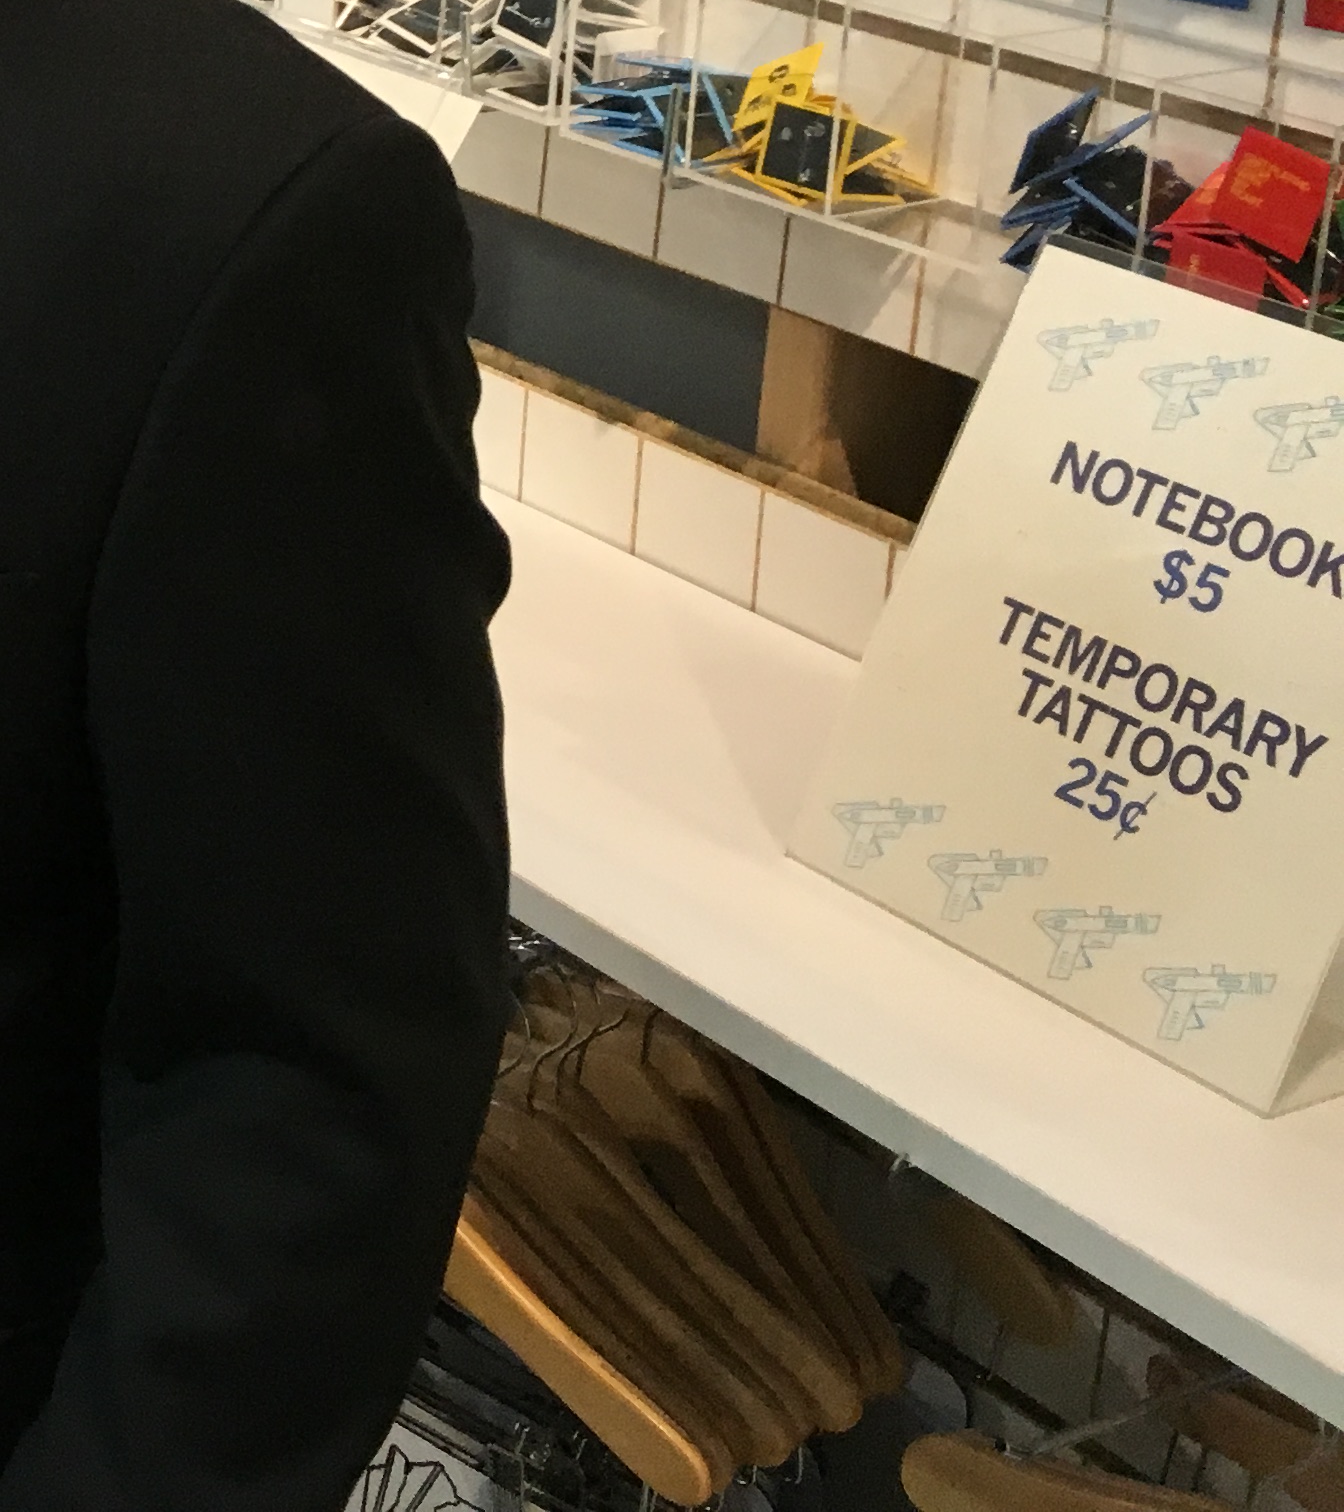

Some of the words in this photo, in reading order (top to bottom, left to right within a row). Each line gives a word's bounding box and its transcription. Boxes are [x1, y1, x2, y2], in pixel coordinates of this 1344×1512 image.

[1153, 549, 1231, 613] $5
[999, 596, 1329, 778] TEMPORARY
[1018, 668, 1250, 813] TATTOOS
[1054, 757, 1157, 841] 25¢
